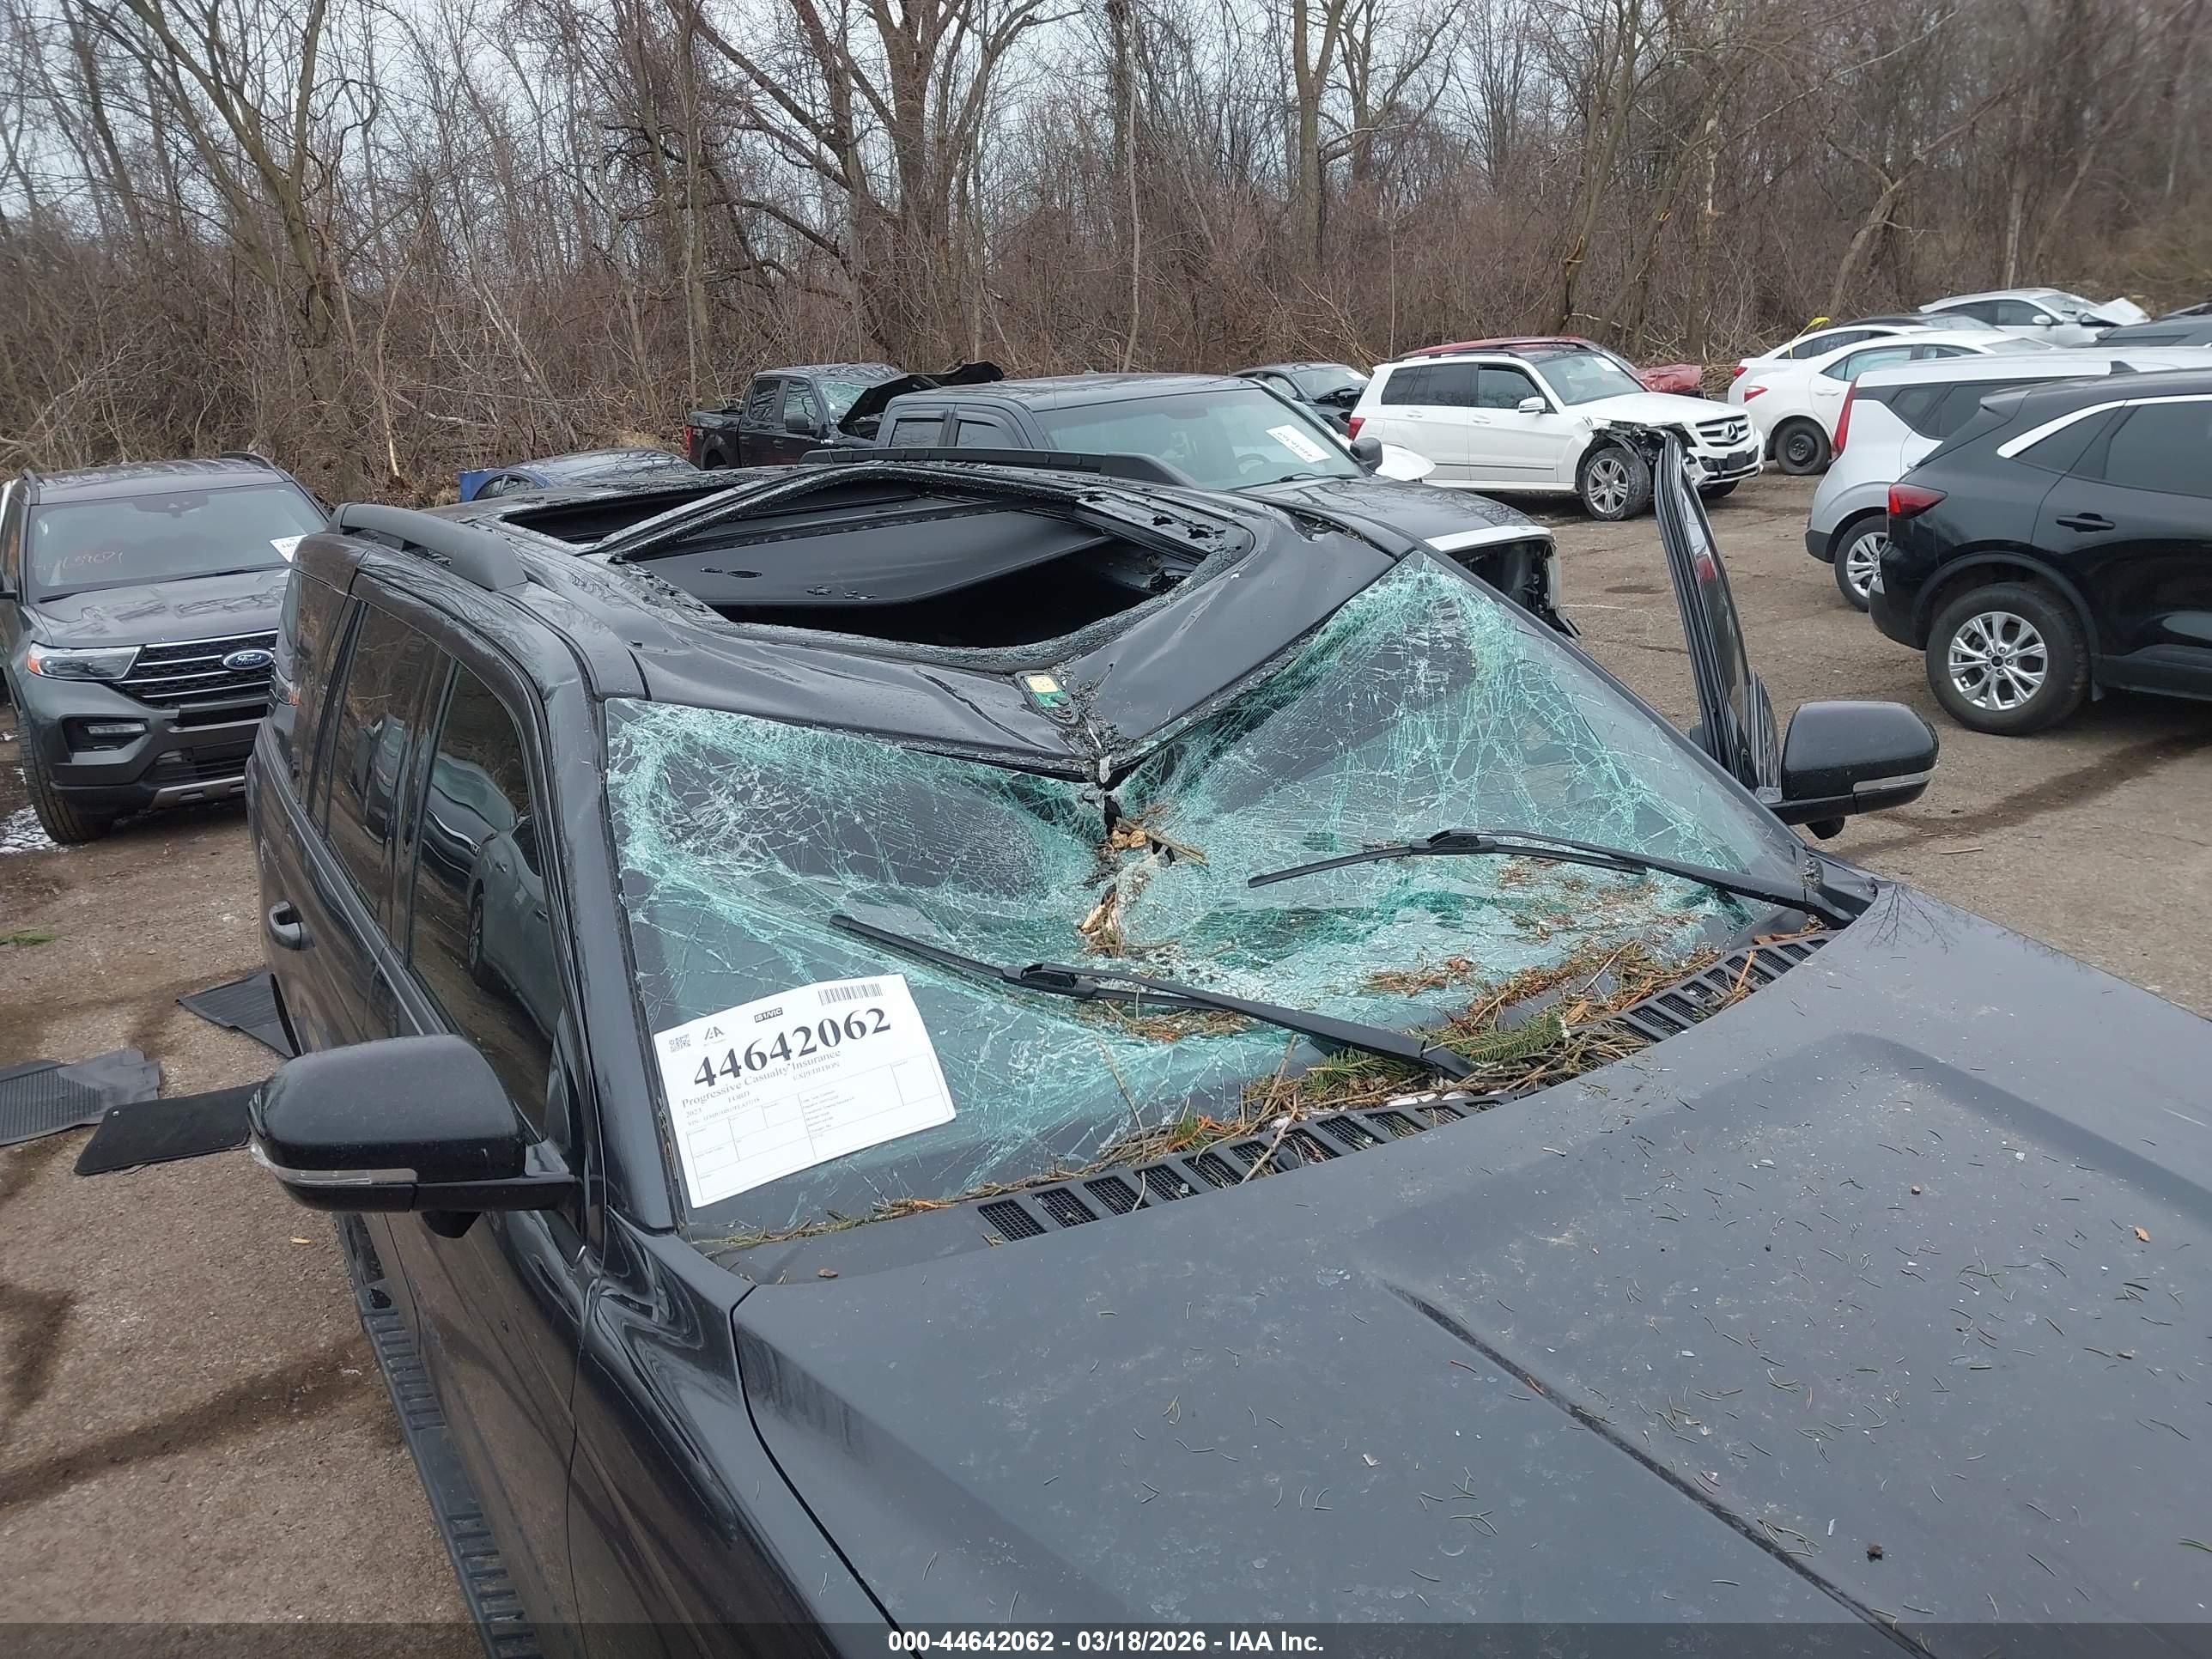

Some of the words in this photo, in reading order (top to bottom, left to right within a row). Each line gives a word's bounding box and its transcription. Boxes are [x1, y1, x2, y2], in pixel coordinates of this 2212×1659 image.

[234, 653, 262, 665] Ford
[694, 1007, 890, 1087] 44642062
[682, 1082, 742, 1108] Progressive
[744, 1064, 789, 1086] Casualty
[792, 1049, 842, 1072] Insurance
[728, 1091, 750, 1103] FORD
[793, 1061, 841, 1081] EXPEDITION
